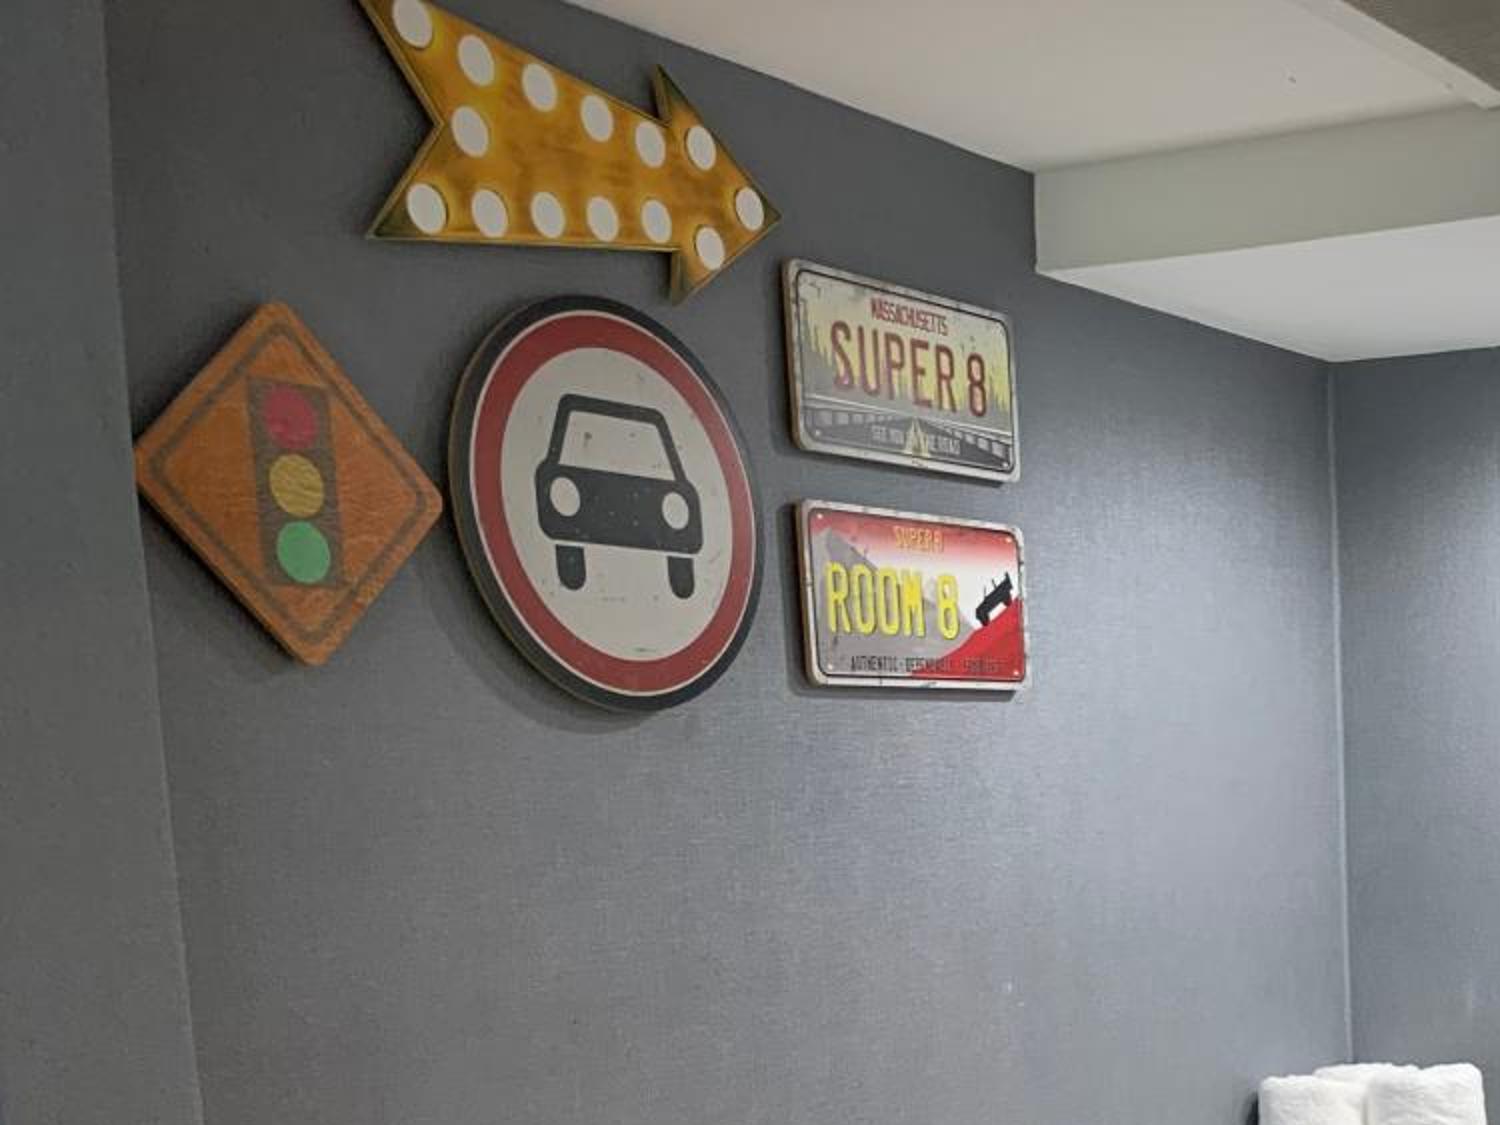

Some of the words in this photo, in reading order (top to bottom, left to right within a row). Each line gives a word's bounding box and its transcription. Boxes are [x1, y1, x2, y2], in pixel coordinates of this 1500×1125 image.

[870, 297, 948, 336] MASSACHUSETTS
[830, 320, 957, 413] SUPER
[966, 352, 988, 417] 8
[826, 562, 925, 637] ROOM
[937, 575, 960, 640] 8
